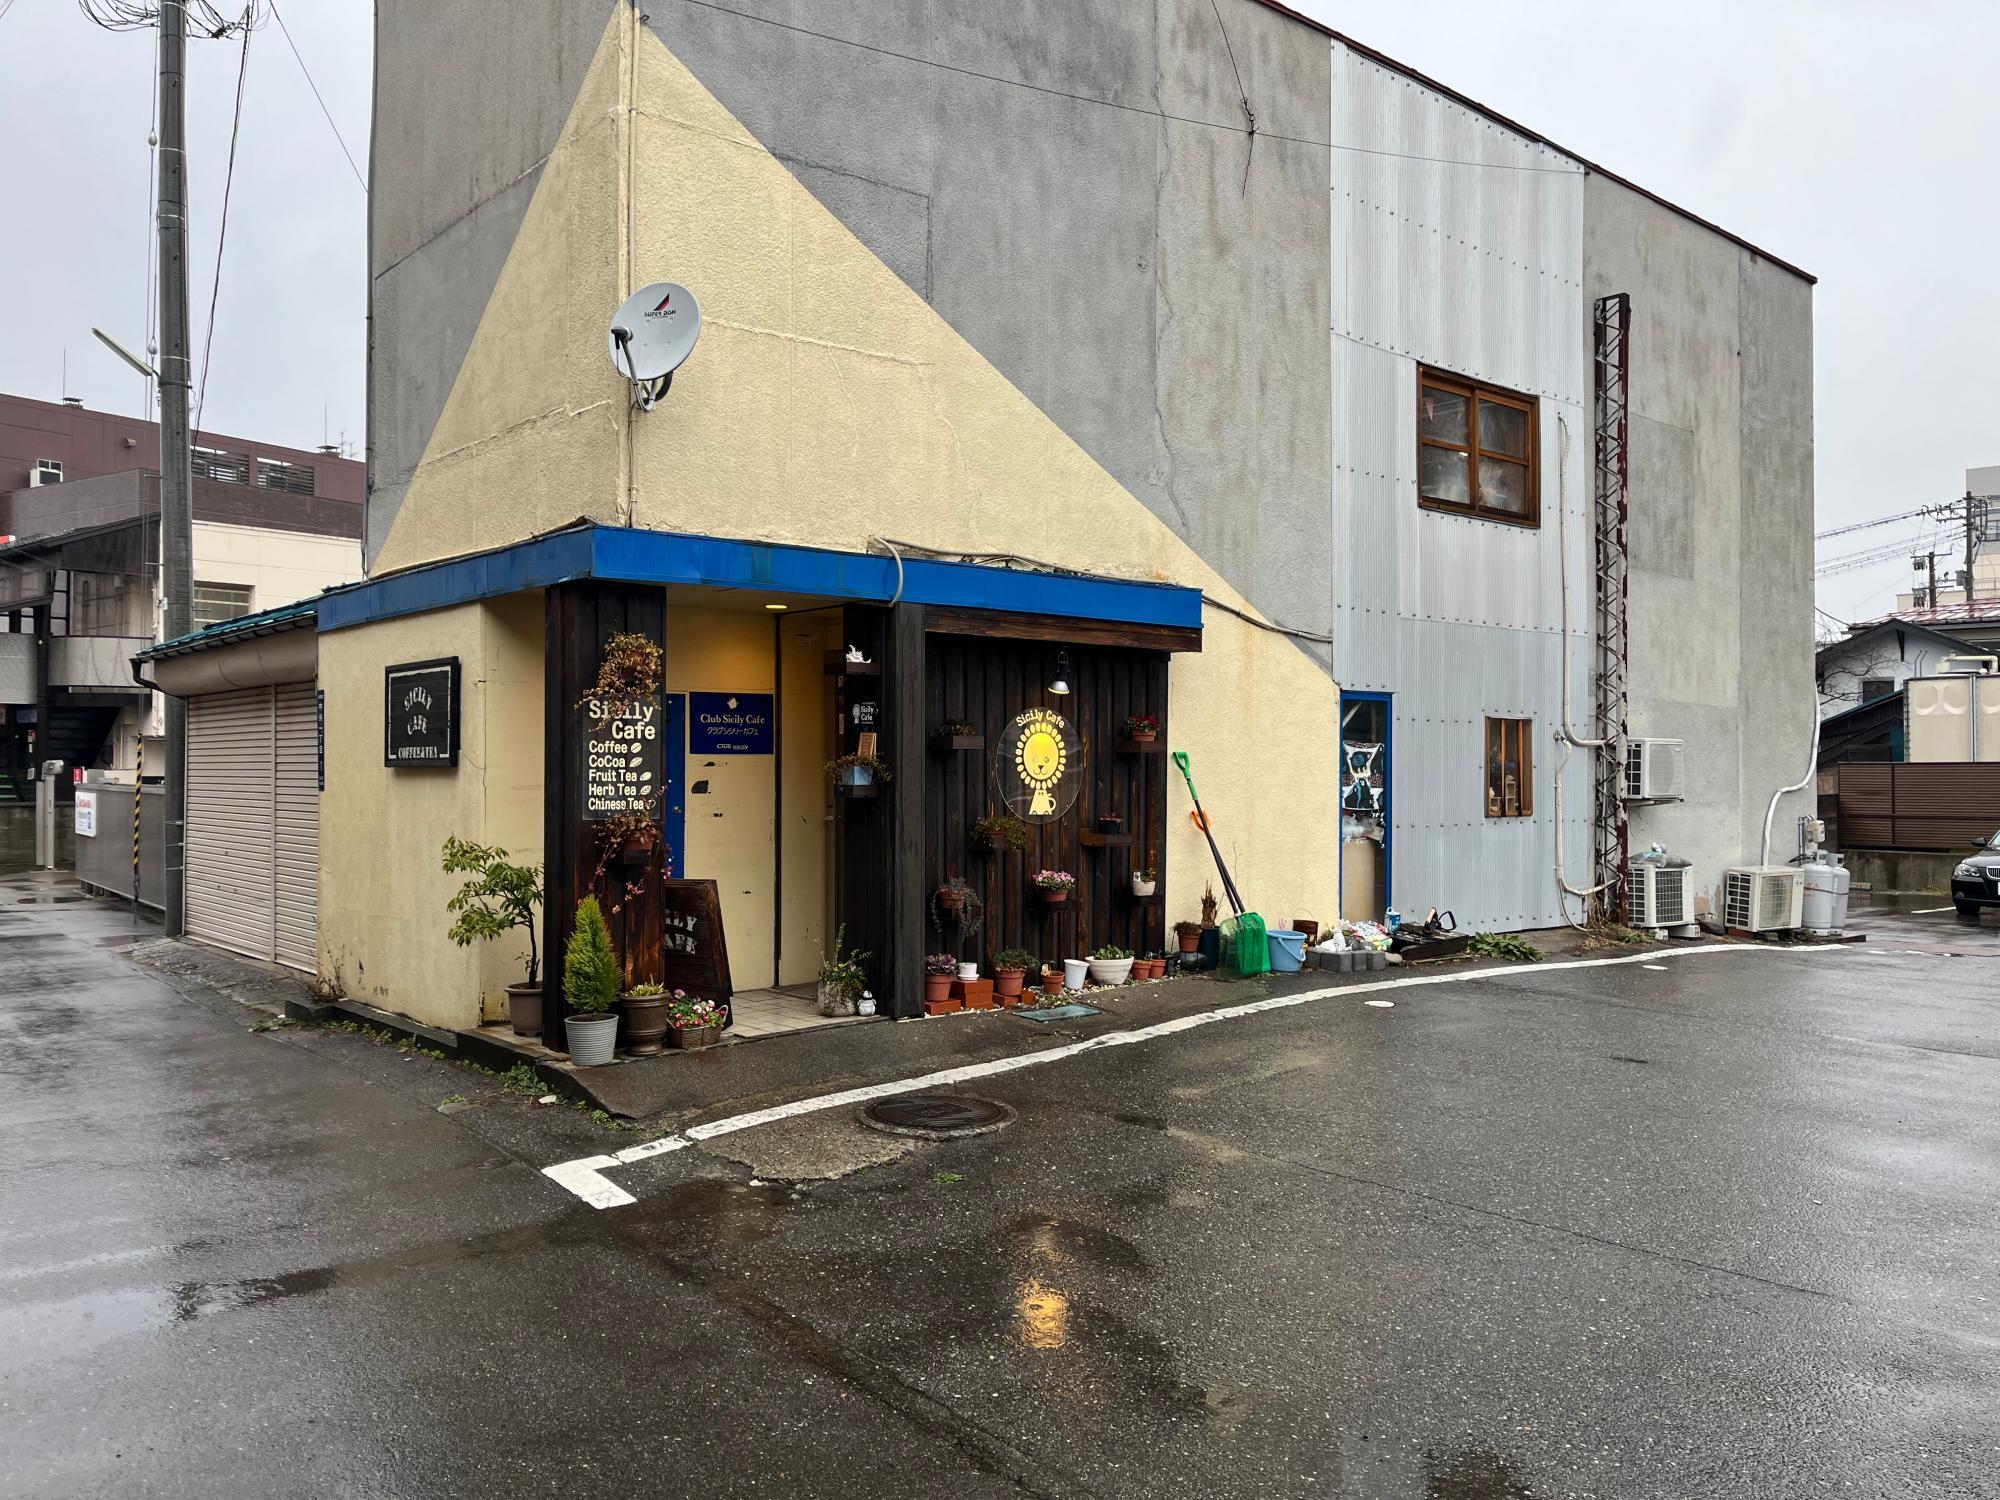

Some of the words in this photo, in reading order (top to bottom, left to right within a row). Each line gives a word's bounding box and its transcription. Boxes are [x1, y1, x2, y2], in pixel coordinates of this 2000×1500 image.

[404, 687, 432, 711] SICILY
[407, 715, 427, 735] CAFE
[700, 713, 721, 724] Club
[722, 714, 744, 726] Sicily
[746, 714, 765, 724] Cafe
[1016, 709, 1044, 727] Sicily
[1046, 710, 1065, 729] Cafe
[612, 721, 655, 739] Cafe
[588, 740, 628, 753] Coffee
[588, 755, 626, 768] CoCoa
[588, 769, 617, 782] Fruit
[618, 769, 637, 782] Tea
[588, 783, 615, 796] Herb
[616, 783, 637, 796] Tea
[588, 797, 627, 811] Chinese
[627, 798, 644, 810] Tea
[664, 909, 697, 932] ILY
[664, 933, 697, 955] AFE
